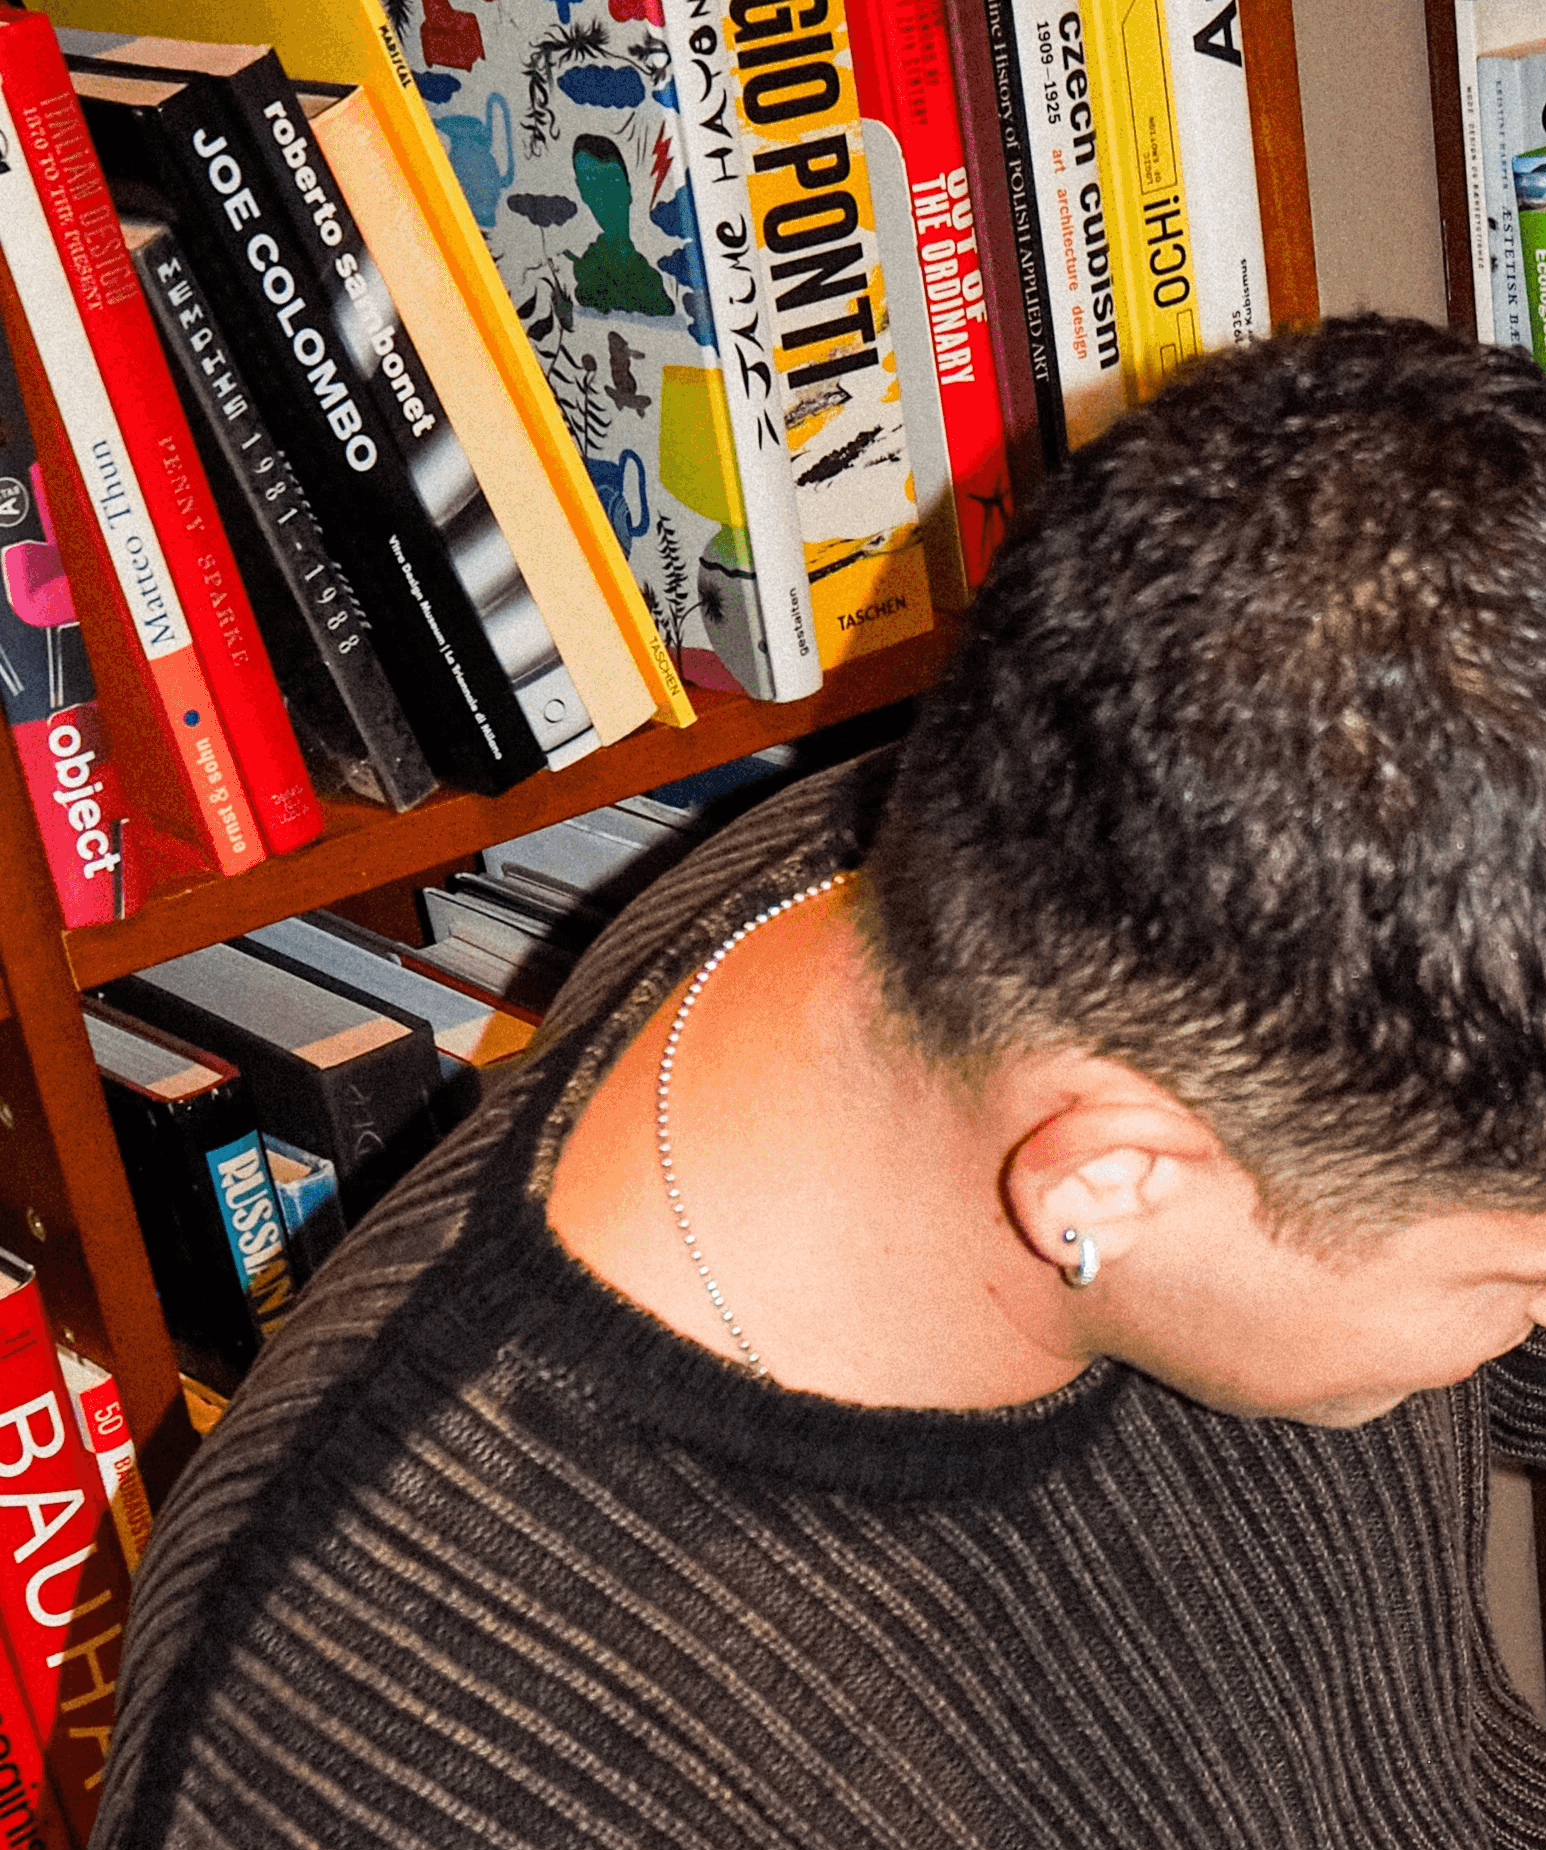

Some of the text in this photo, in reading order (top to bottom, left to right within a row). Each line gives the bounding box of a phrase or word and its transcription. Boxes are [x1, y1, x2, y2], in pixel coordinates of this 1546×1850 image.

[262, 100, 440, 439] roberto sambonet
[727, 0, 880, 390] GIO PONTI
[911, 172, 952, 236] THE
[946, 166, 989, 325] OUT OF
[1003, 121, 1052, 383] of POLISH APPLIED ART
[1052, 148, 1088, 361] art architecture design
[1059, 10, 1121, 371] czech cubism
[61, 228, 106, 314] PRESENT
[193, 128, 379, 473] JOE COLOMBO
[921, 238, 976, 387] ORDINARY
[1240, 257, 1254, 328] Kubismus
[156, 260, 362, 656] MEMPHIS 1981 1988
[90, 438, 178, 646] Matteo Thun
[157, 434, 251, 669] PENNY SPARKE
[836, 594, 909, 633] TASCHEN
[416, 599, 451, 647] Museum
[646, 634, 682, 699] TASCHEN
[786, 586, 810, 658] gestalten
[46, 722, 121, 881] object
[194, 736, 247, 856] ernst sohn
[93, 1401, 124, 1436] 50
